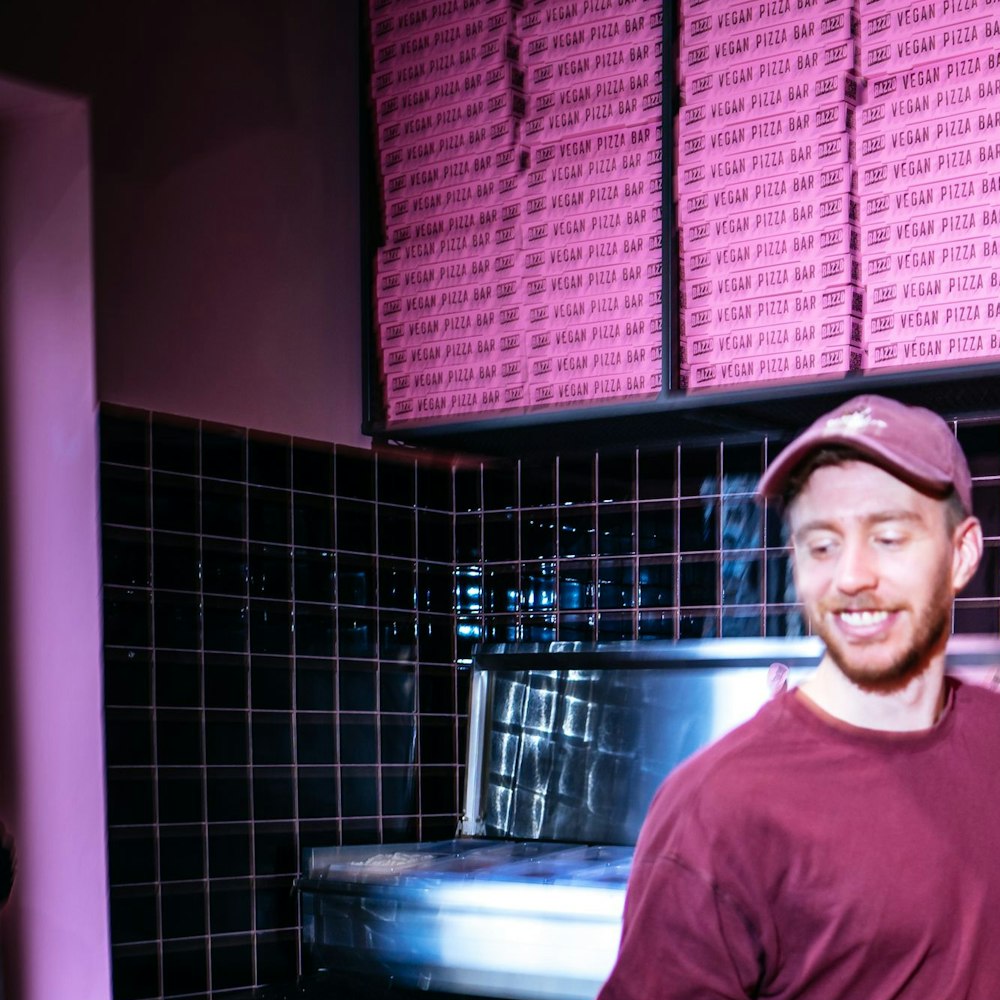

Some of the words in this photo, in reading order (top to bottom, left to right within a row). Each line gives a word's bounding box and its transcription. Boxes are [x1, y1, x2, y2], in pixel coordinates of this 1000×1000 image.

[553, 32, 585, 48] VEGAN
[591, 23, 619, 41] PIZZA
[625, 16, 645, 32] BAR
[715, 37, 749, 58] VEGAN
[756, 28, 787, 48] PIZZA
[794, 22, 814, 40] BAR
[897, 36, 935, 57] VEGAN
[944, 26, 977, 47] PIZZA
[903, 67, 940, 89] VEGAN
[947, 57, 981, 78] PIZZA
[405, 117, 432, 134] VEGAN
[437, 108, 462, 126] PIZZA
[467, 102, 483, 118] BAR
[894, 158, 931, 179] VEGAN
[939, 150, 972, 170] PIZZA
[897, 219, 934, 239] VEGAN
[942, 213, 975, 232] PIZZA
[554, 302, 584, 318] VEGAN
[591, 298, 618, 313] PIZZA
[625, 294, 643, 309] BAR
[718, 303, 751, 322] VEGAN
[759, 299, 788, 316] PIZZA
[796, 295, 816, 311] BAR
[901, 311, 938, 328] VEGAN
[946, 305, 980, 323] PIZZA
[409, 320, 438, 336] VEGAN
[444, 317, 471, 331] PIZZA
[477, 313, 494, 326] BAR
[557, 353, 587, 370] VEGAN
[594, 351, 621, 367] PIZZA
[627, 349, 645, 363] BAR
[722, 362, 753, 378] VEGAN
[761, 357, 789, 374] PIZZA
[796, 355, 815, 369] BAR
[415, 372, 443, 387] VEGAN
[449, 368, 474, 383] PIZZA
[480, 365, 496, 379] BAR
